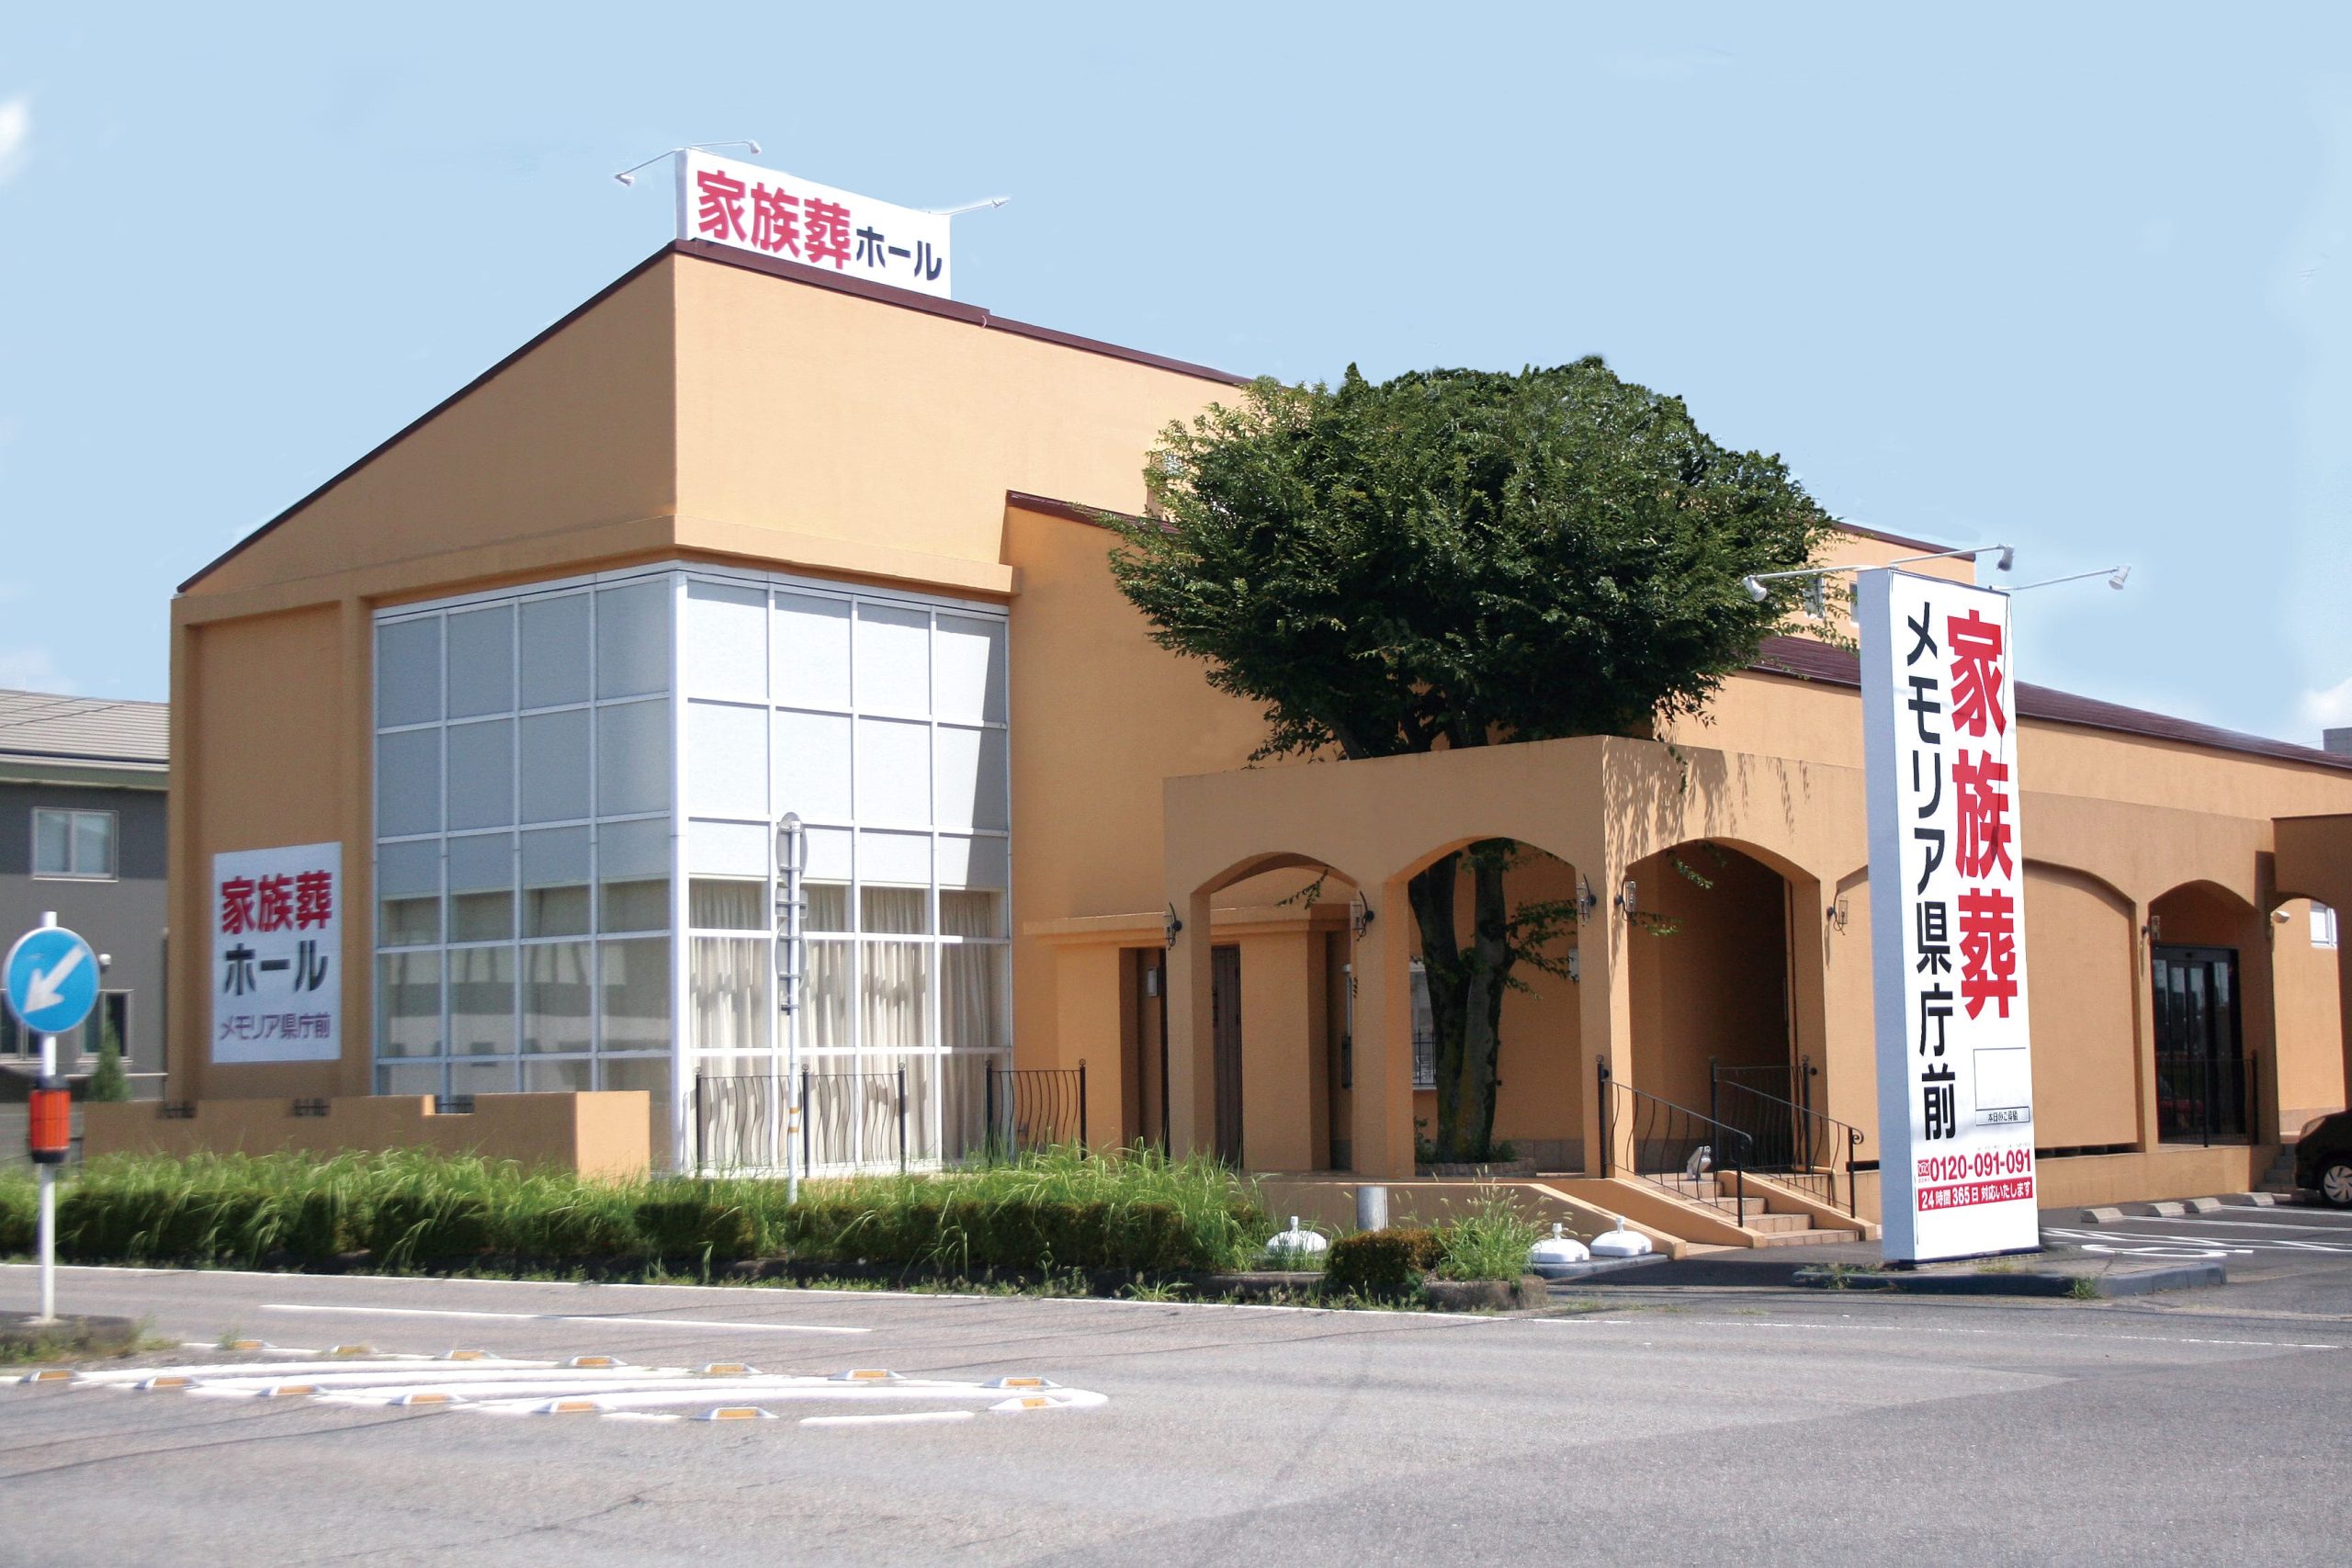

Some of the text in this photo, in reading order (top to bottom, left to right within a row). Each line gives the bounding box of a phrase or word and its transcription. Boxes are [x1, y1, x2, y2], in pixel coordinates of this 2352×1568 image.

[697, 170, 943, 281] 家族葬ホール
[1947, 609, 2018, 1021] 家族葬
[221, 870, 333, 934] 家族葬
[1907, 602, 1956, 1141] メモリア県庁前
[224, 938, 329, 997] ホール
[220, 1012, 331, 1041] メモリア県庁前
[1930, 1148, 2031, 1182] 0120-091-091
